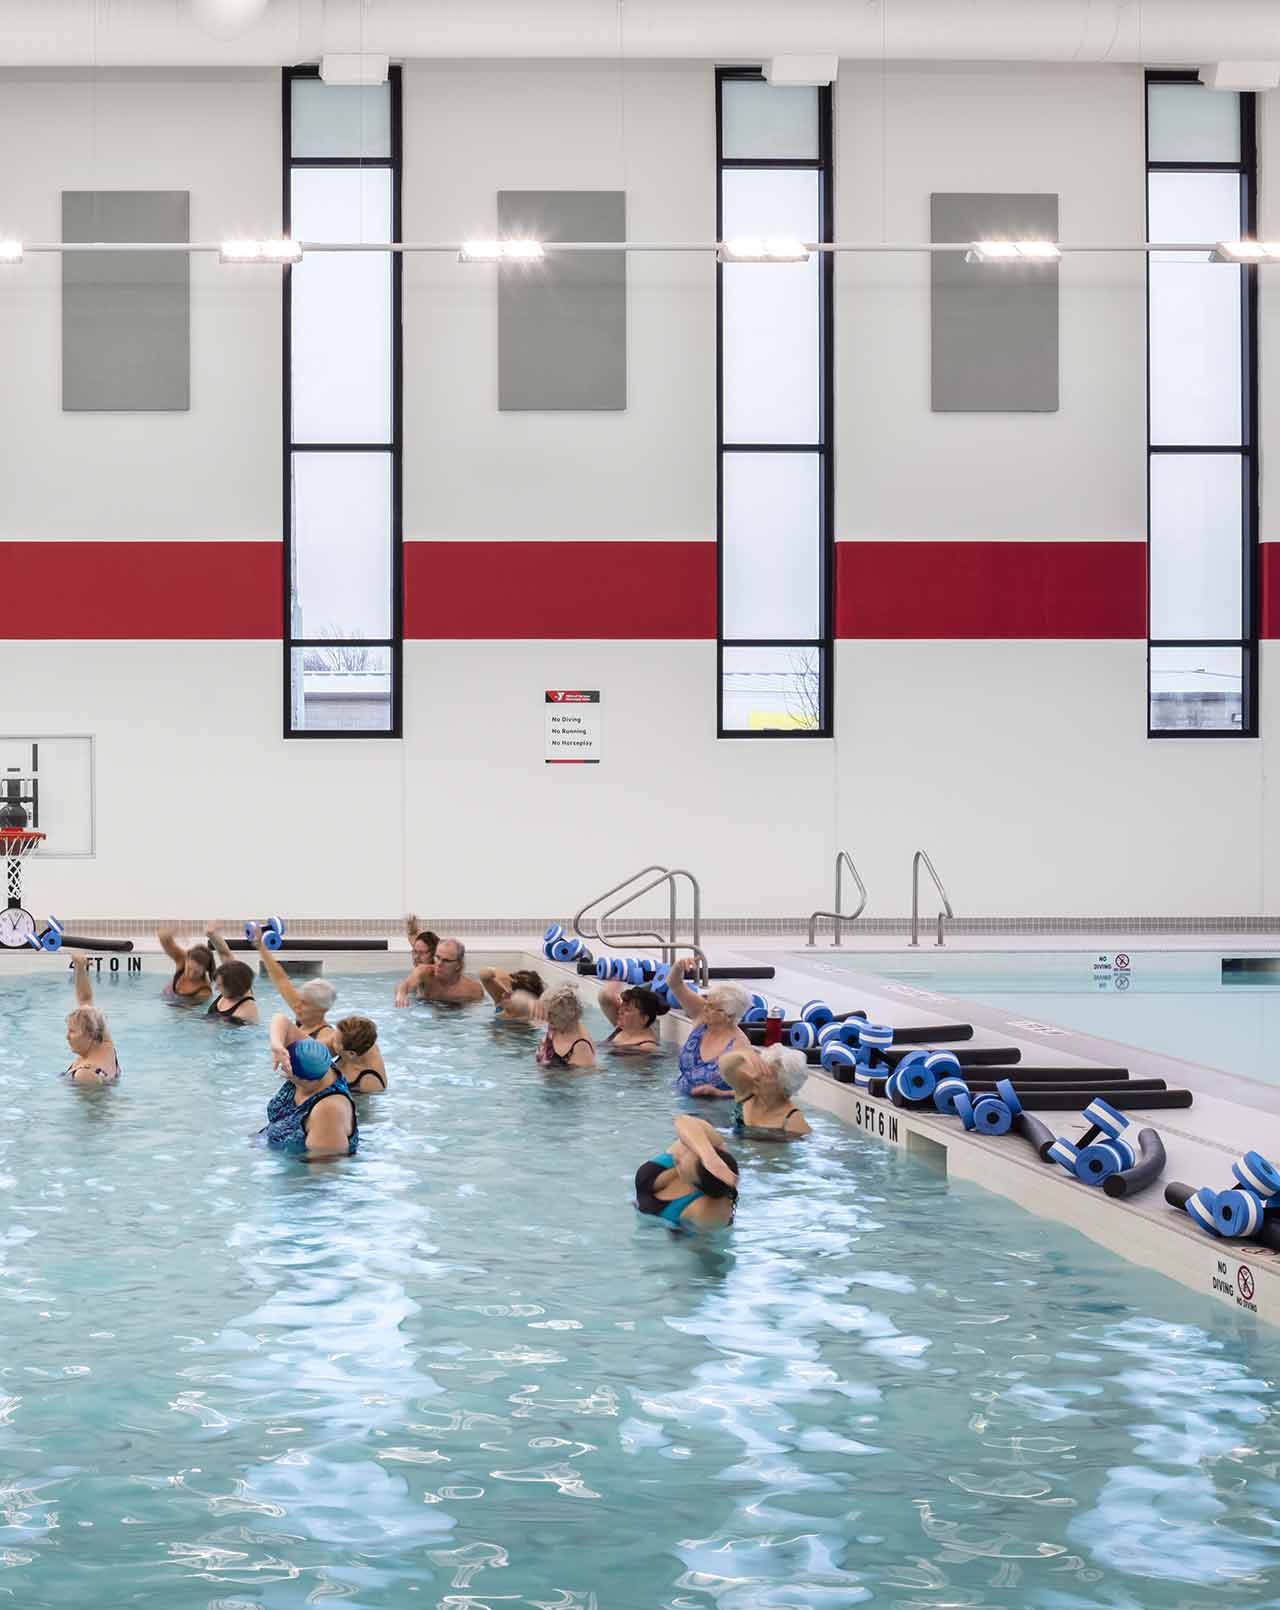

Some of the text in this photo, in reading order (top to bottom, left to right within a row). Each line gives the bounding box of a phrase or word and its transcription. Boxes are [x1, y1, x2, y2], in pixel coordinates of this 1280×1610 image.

[86, 957, 103, 972] FT
[128, 957, 141, 971] IN
[856, 1101, 898, 1142] 3 FT 6 IN
[1218, 1261, 1227, 1275] NO
[1213, 1276, 1233, 1296] DIVING
